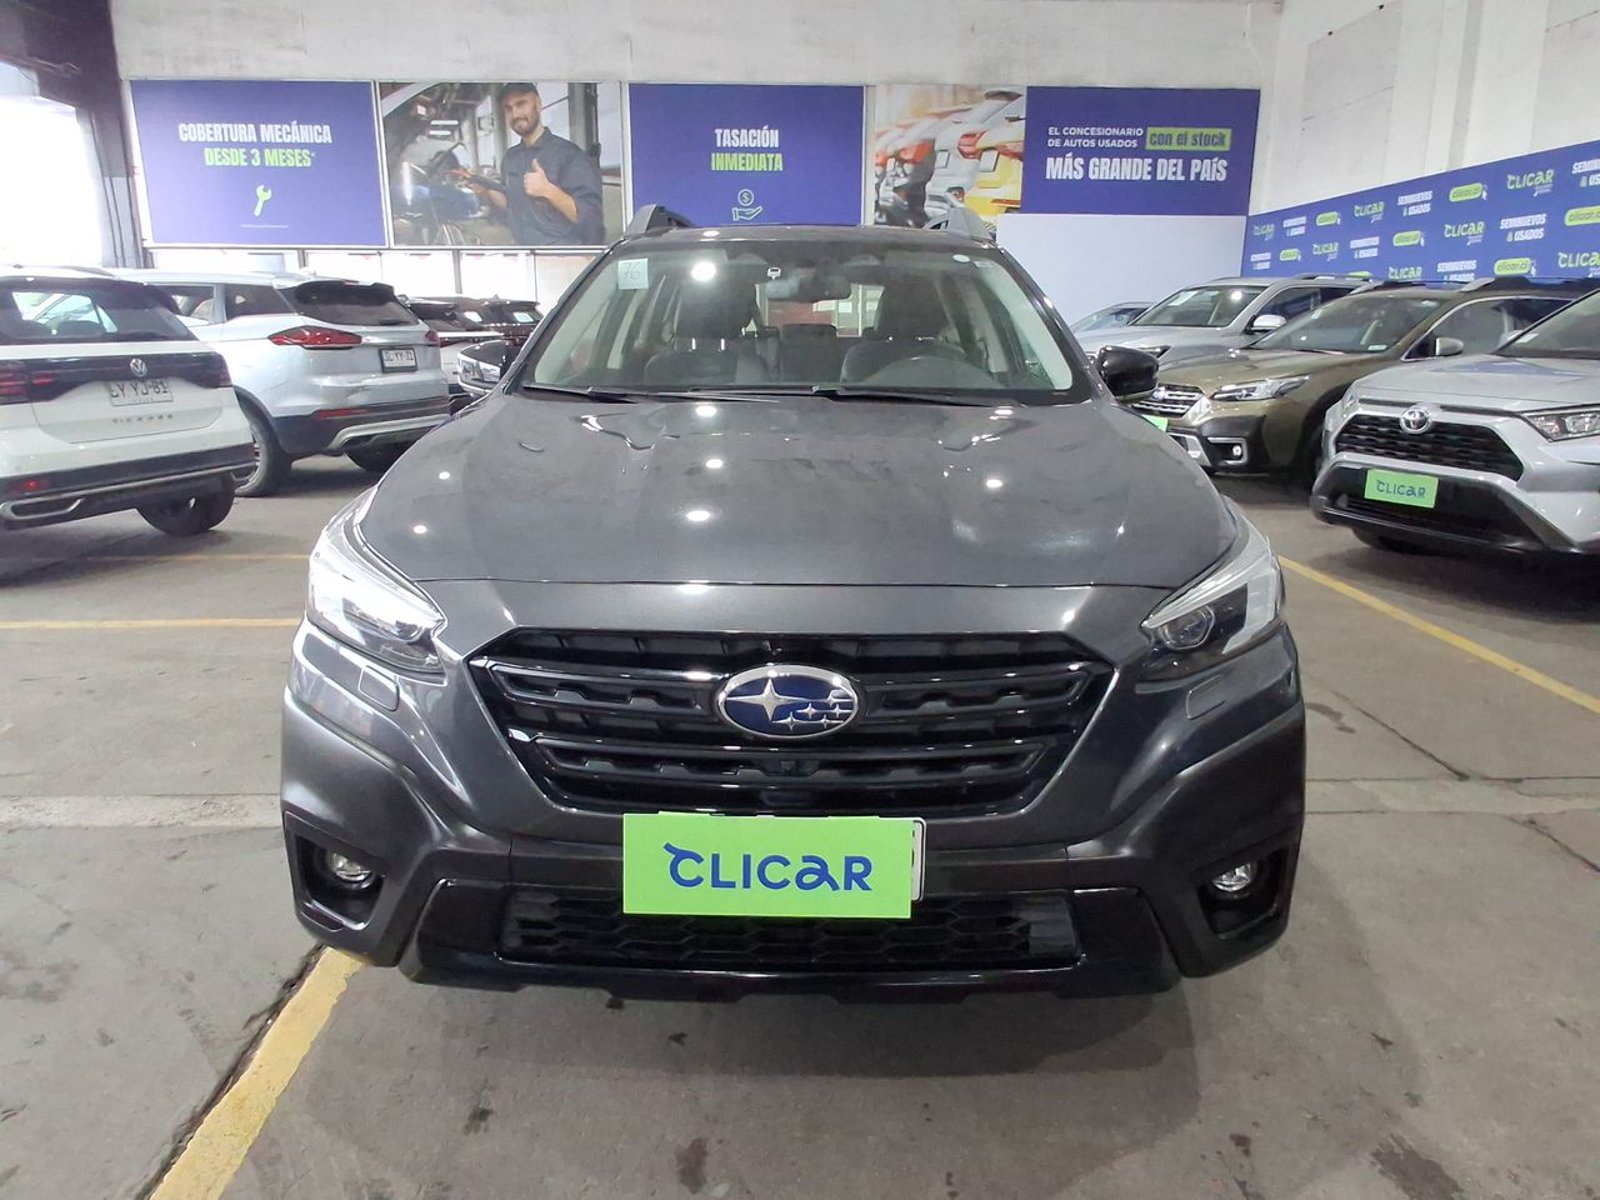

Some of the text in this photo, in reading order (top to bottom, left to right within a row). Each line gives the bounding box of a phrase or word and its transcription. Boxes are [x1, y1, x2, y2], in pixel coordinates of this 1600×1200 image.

[178, 120, 333, 143] COBERTURA MECÁNICA
[714, 125, 780, 148] TASACIÓN
[1048, 127, 1144, 137] EL CONCESIONARIO
[1151, 132, 1226, 146] con el stock
[1047, 138, 1138, 148] DE AUTOS USADOS
[204, 147, 248, 166] DESDE
[251, 148, 261, 166] 3
[711, 152, 783, 171] INMEDIATA
[1045, 152, 1084, 180] MÁS
[1088, 157, 1153, 180] GRANDE
[1156, 158, 1186, 181] DEL
